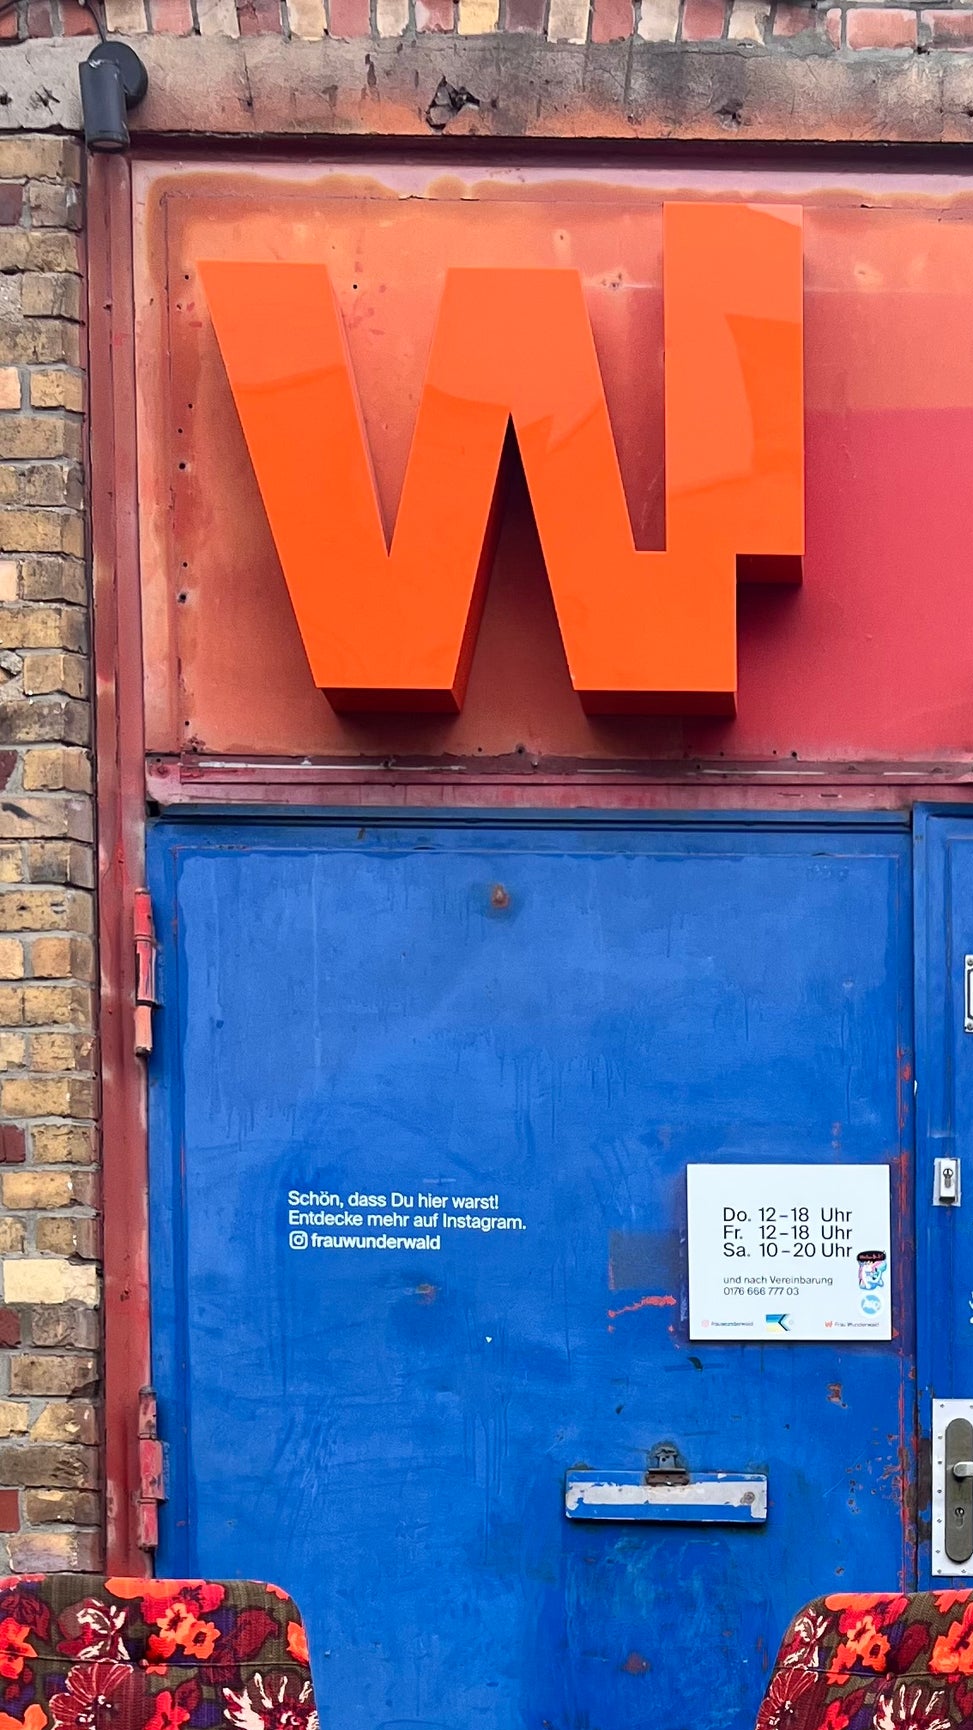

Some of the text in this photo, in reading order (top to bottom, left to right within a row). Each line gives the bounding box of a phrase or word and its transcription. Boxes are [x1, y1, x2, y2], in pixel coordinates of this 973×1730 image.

[196, 202, 804, 716] W
[288, 1189, 499, 1210] Schön, dass Du hier warst!
[288, 1210, 527, 1232] Entdecke mehr auf Instagram.
[723, 1207, 751, 1222] Do.
[821, 1207, 852, 1222] Uhr
[723, 1225, 743, 1240] Fr.
[821, 1225, 852, 1240] Uhr
[311, 1232, 441, 1250] frauwunderwald
[723, 1242, 750, 1257] Sa.
[821, 1242, 852, 1257] Uhr
[723, 1275, 833, 1286] und nach Vereinbarung
[723, 1286, 744, 1296] 0176
[768, 1286, 784, 1296] 777
[786, 1286, 799, 1296] 03
